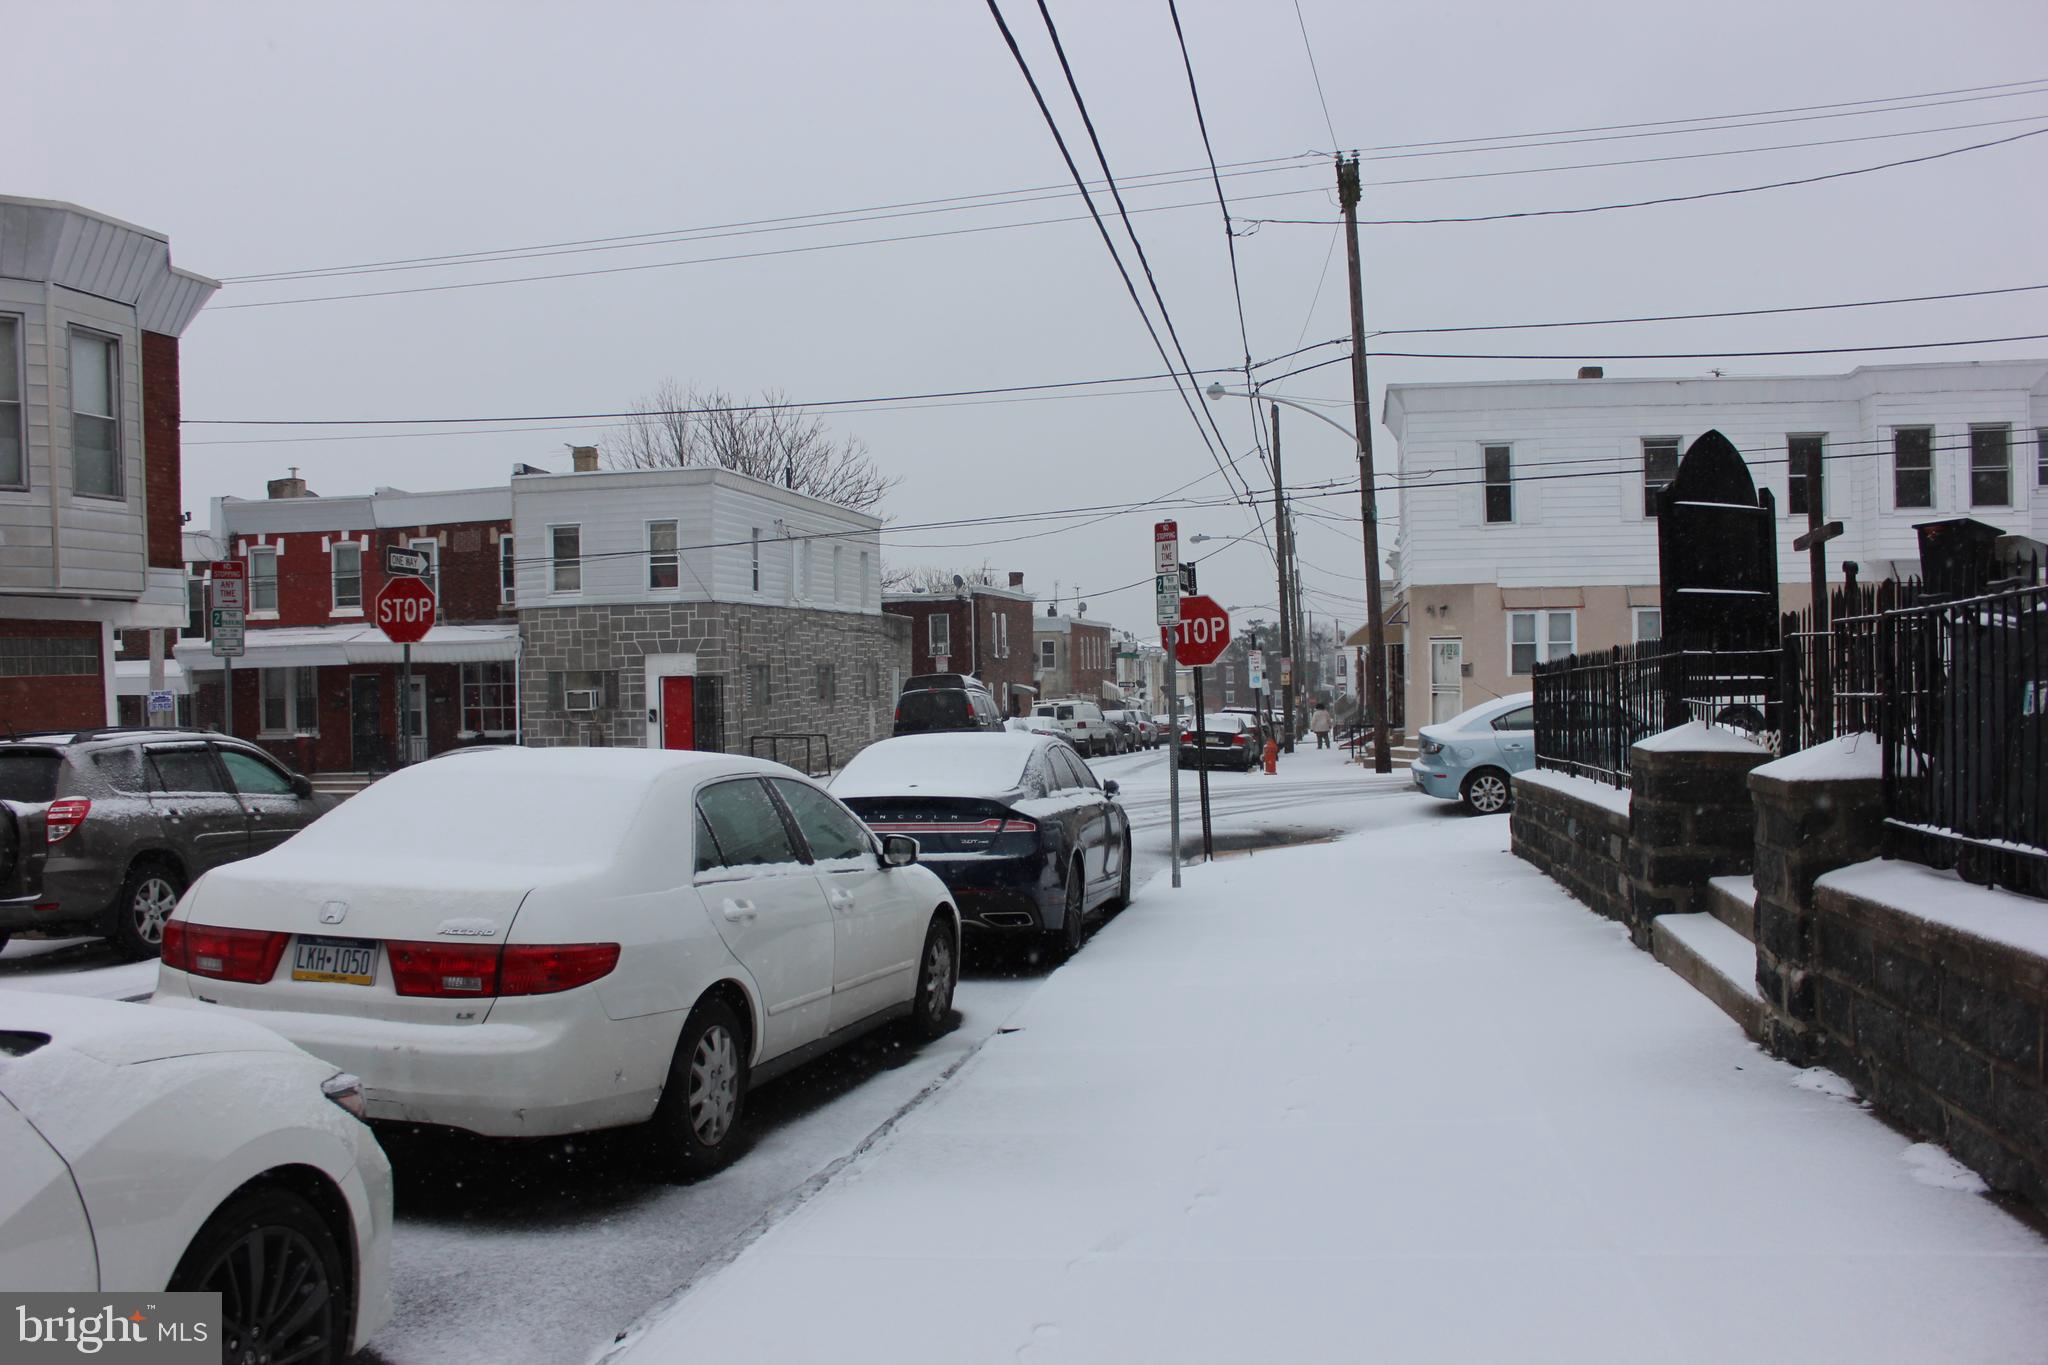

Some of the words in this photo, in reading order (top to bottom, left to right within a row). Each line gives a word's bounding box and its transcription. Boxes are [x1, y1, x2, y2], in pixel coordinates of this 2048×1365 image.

[1162, 543, 1171, 551] ANY
[391, 554, 404, 566] ONE
[405, 557, 418, 568] WAY
[1161, 552, 1172, 560] TIME
[221, 581, 234, 589] ANY
[1158, 578, 1162, 591] 2
[220, 590, 236, 598] TIME
[380, 598, 432, 623] STOP
[214, 612, 221, 625] 2
